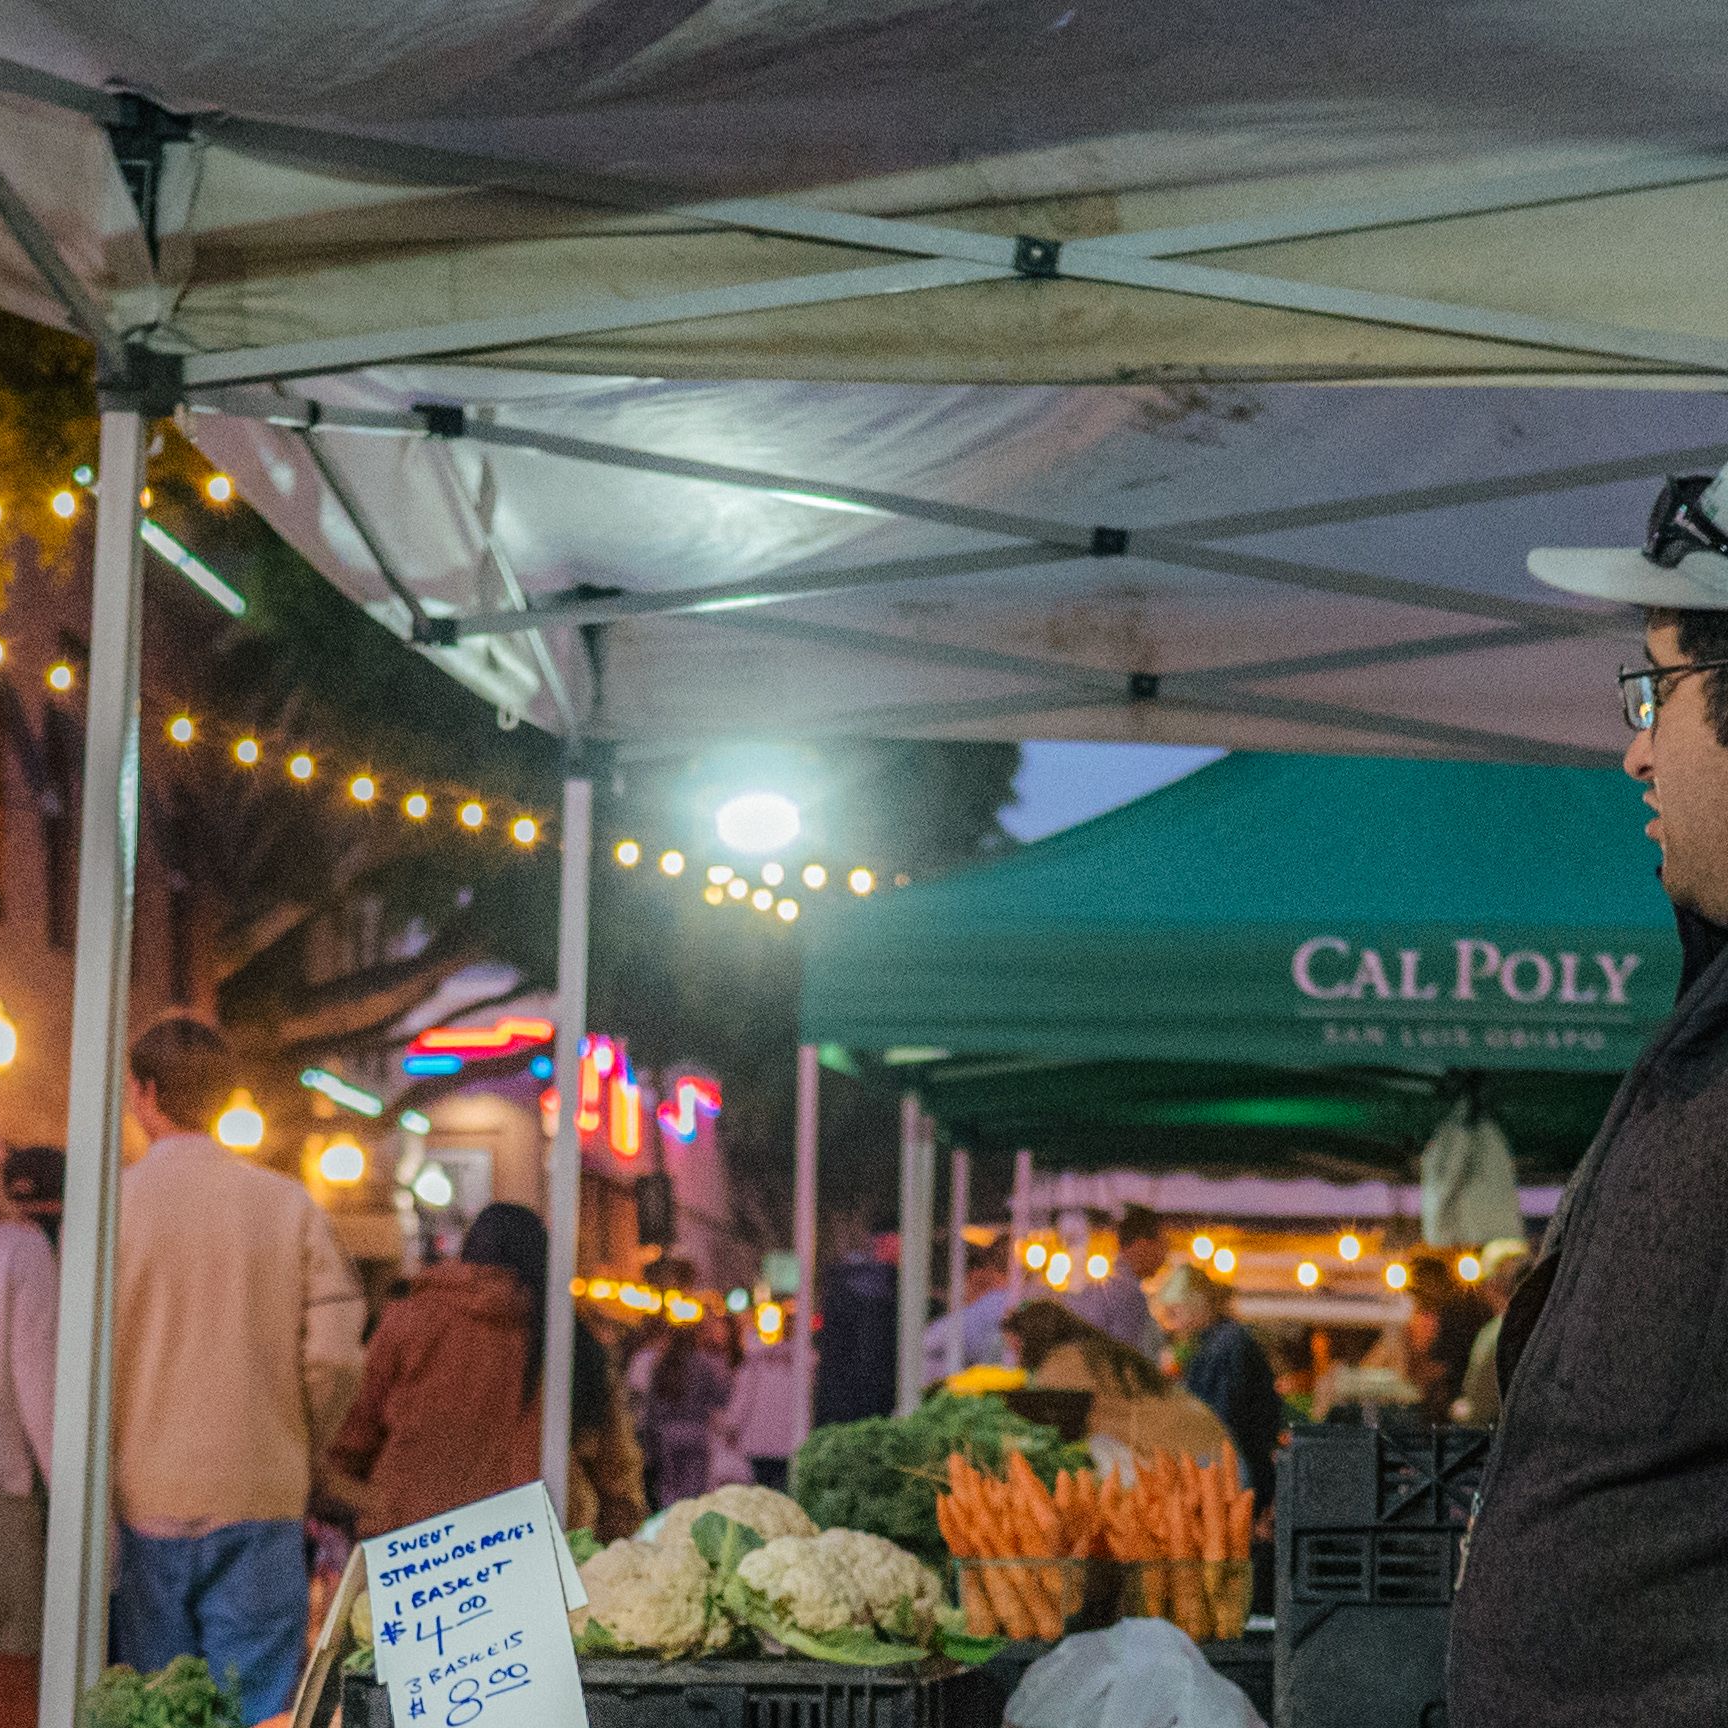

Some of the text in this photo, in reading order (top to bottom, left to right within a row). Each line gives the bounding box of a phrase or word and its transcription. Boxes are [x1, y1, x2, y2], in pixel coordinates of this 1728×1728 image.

[1291, 936, 1642, 1004] CAL POLY
[379, 1522, 535, 1587] STRAWBERRIES
[387, 1524, 455, 1557] SWEET
[411, 1560, 513, 1609] BASKET
